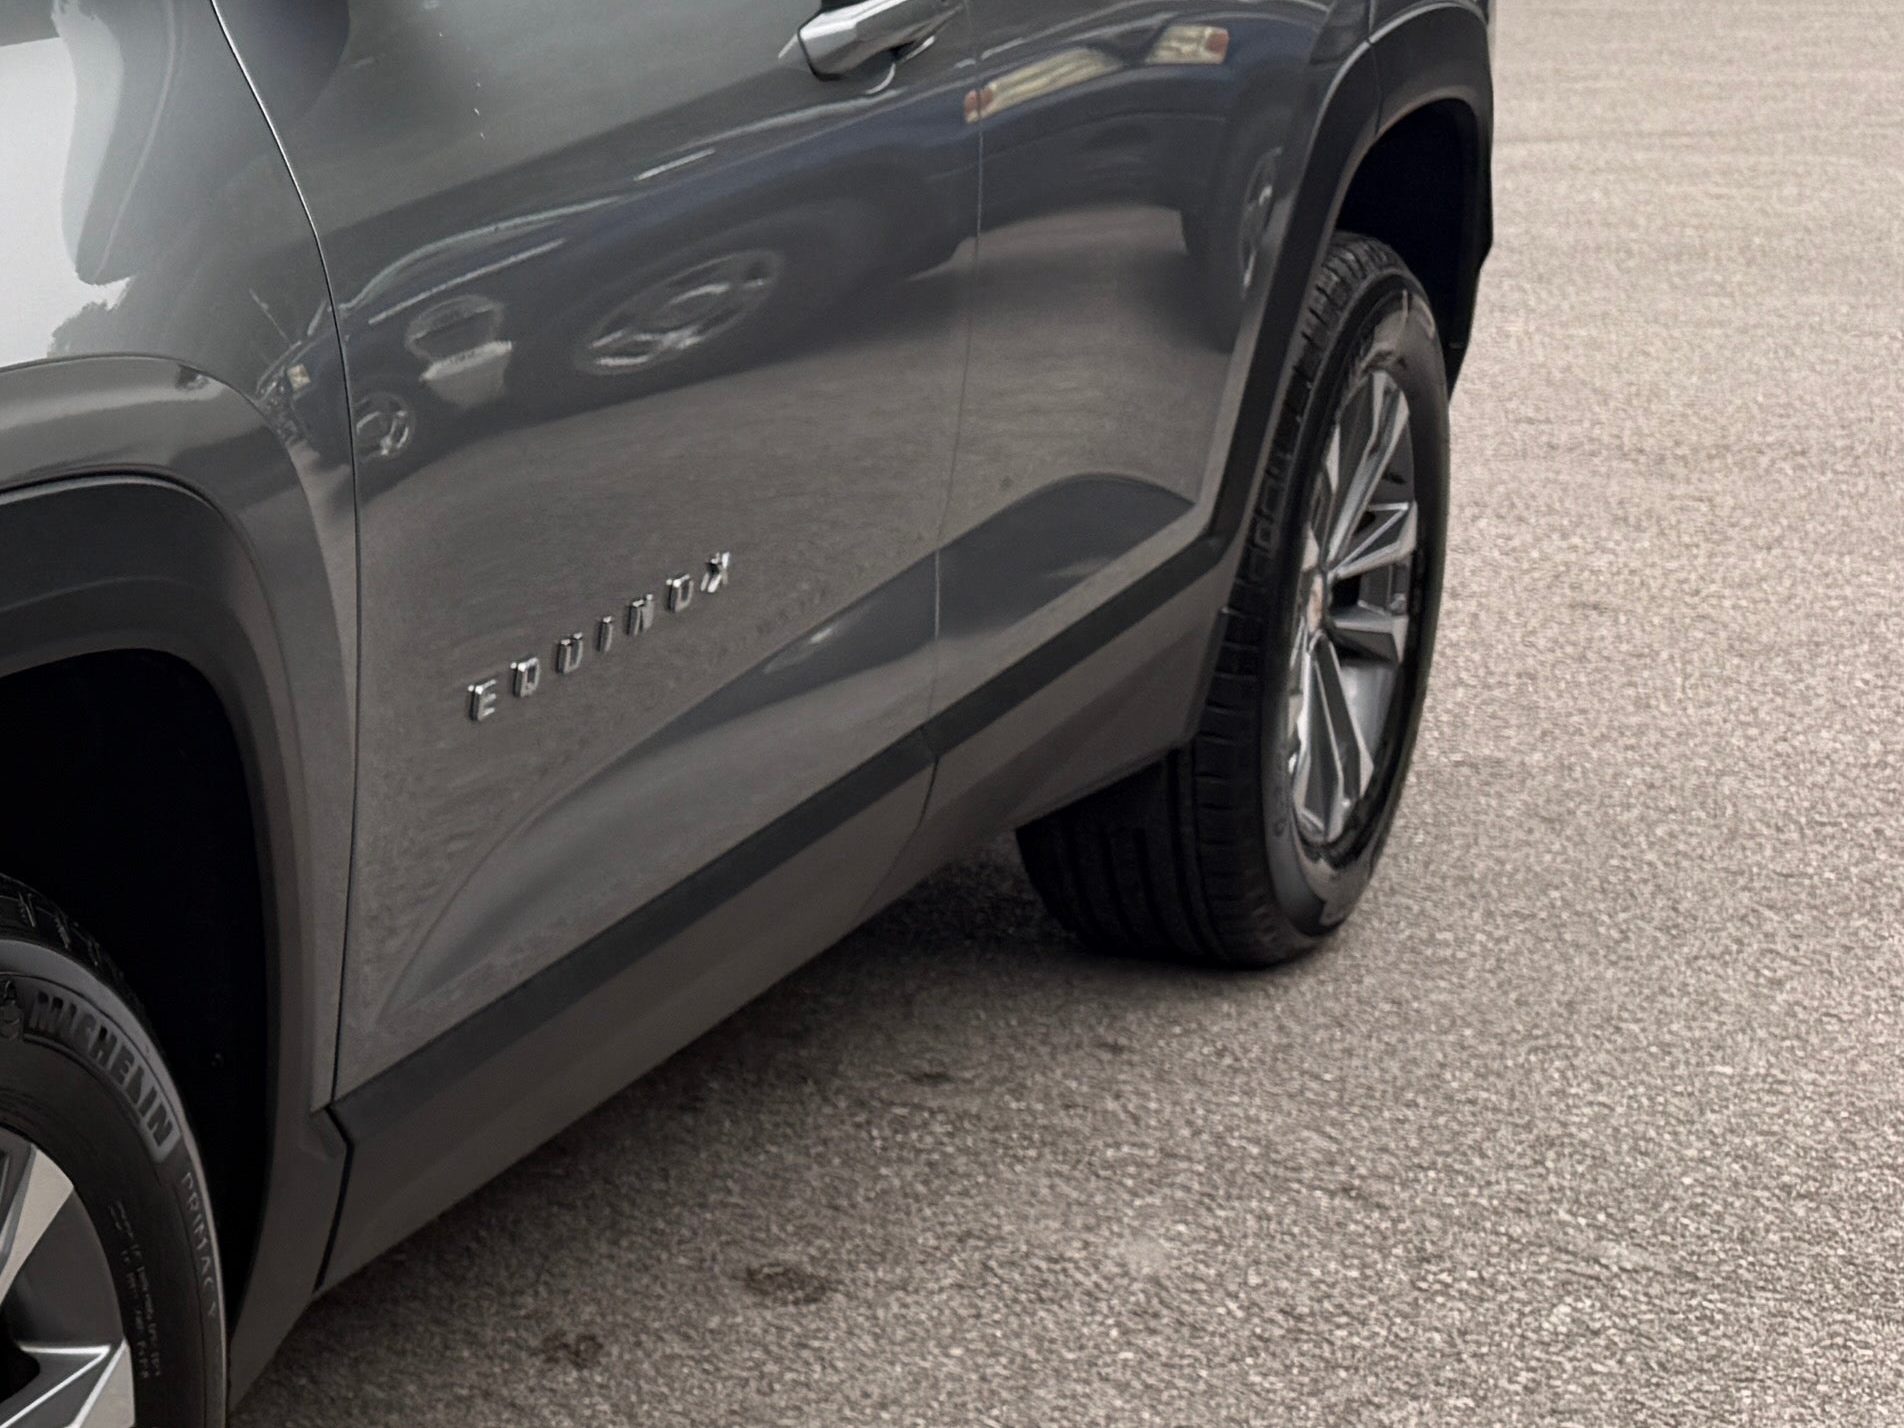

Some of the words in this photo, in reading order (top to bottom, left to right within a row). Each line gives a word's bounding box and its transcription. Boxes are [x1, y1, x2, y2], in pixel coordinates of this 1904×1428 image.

[468, 551, 731, 722] EQUINOX
[28, 990, 176, 1152] MICHELIN
[180, 1170, 219, 1320] PRIMACY
